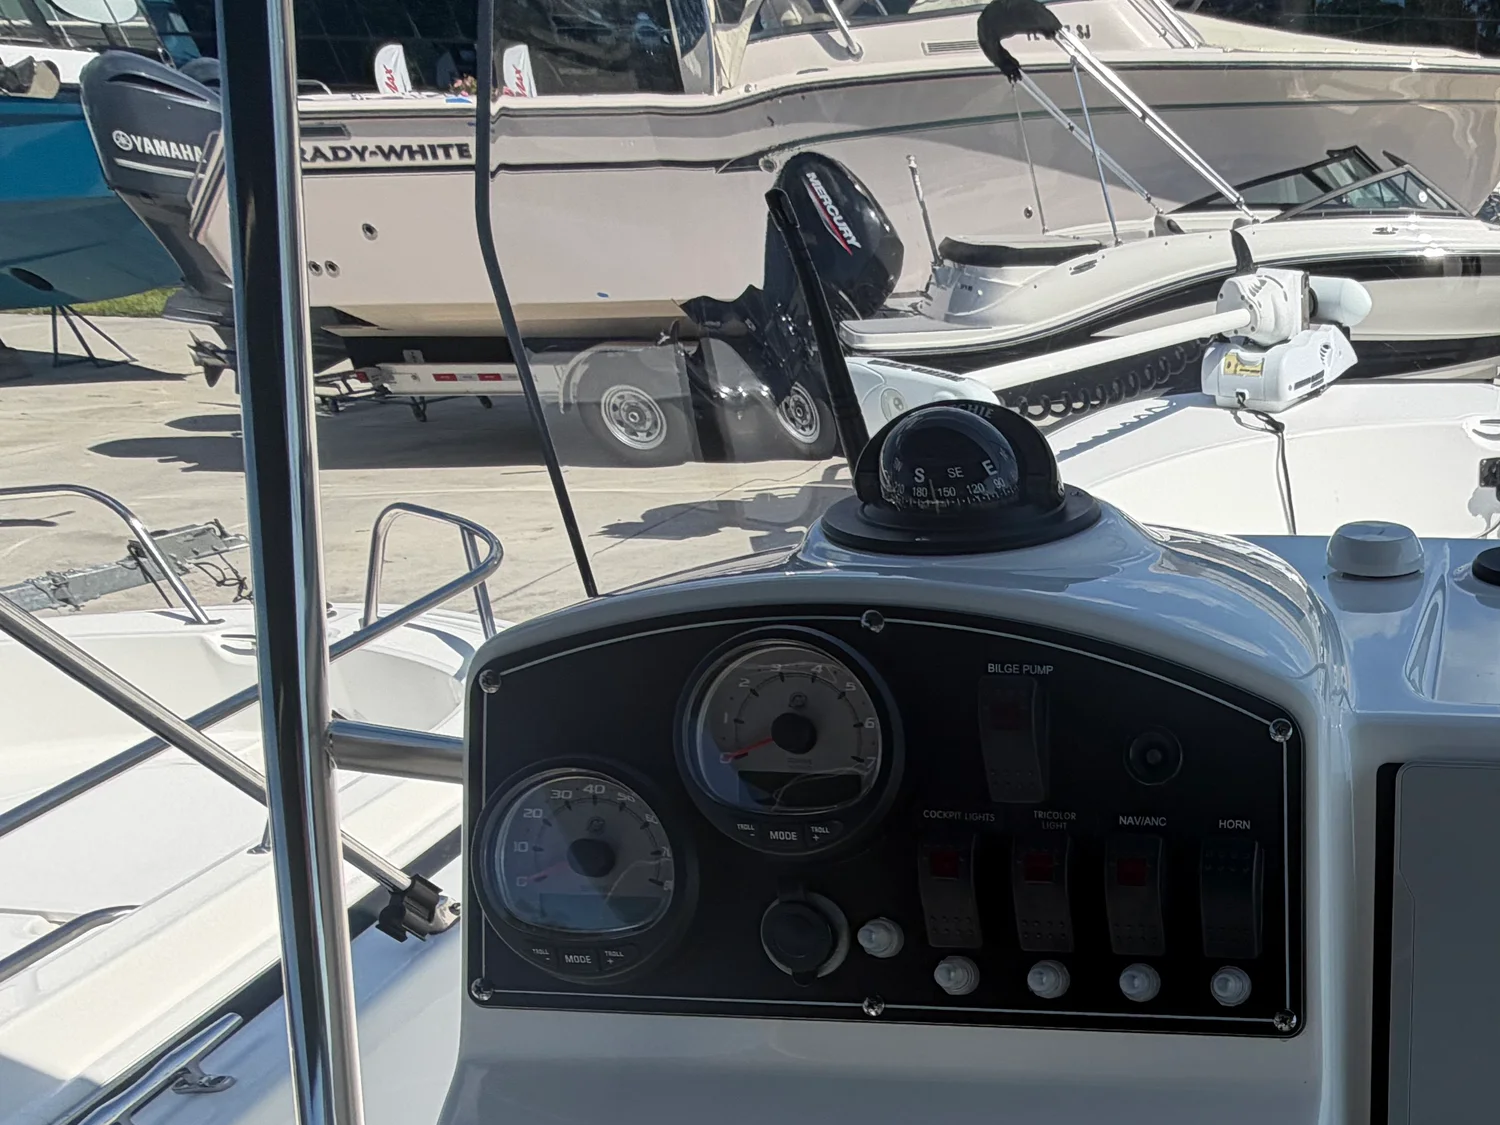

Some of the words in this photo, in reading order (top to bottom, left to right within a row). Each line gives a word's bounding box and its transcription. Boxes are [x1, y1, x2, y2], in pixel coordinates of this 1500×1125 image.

[130, 134, 207, 163] YAMAHA
[300, 143, 472, 163] ADY-WHITE
[806, 172, 861, 248] MERCURY
[947, 466, 964, 478] SE
[981, 459, 998, 476] E
[914, 467, 925, 483] S
[912, 486, 928, 498] 180
[937, 486, 956, 498] 150
[966, 482, 986, 495] 120
[987, 663, 1020, 674] BILGE
[1022, 663, 1054, 675] PUMP
[739, 678, 750, 687] 2
[845, 682, 857, 690] 5
[864, 717, 875, 728] 6
[550, 789, 573, 799] 30
[583, 784, 606, 794] 40
[523, 808, 543, 819] 20
[922, 809, 962, 820] COCKPIT
[964, 812, 996, 822] LIGHTS
[1033, 810, 1077, 821] TRICOLOR
[1041, 820, 1067, 831] LIGHT
[1119, 815, 1167, 827] NAV/ANC
[1218, 818, 1251, 830] HORN
[736, 823, 755, 831] TROLL
[811, 826, 830, 834] TROLL
[770, 830, 798, 841] MODE
[513, 841, 529, 852] 10
[564, 954, 592, 964] MODE
